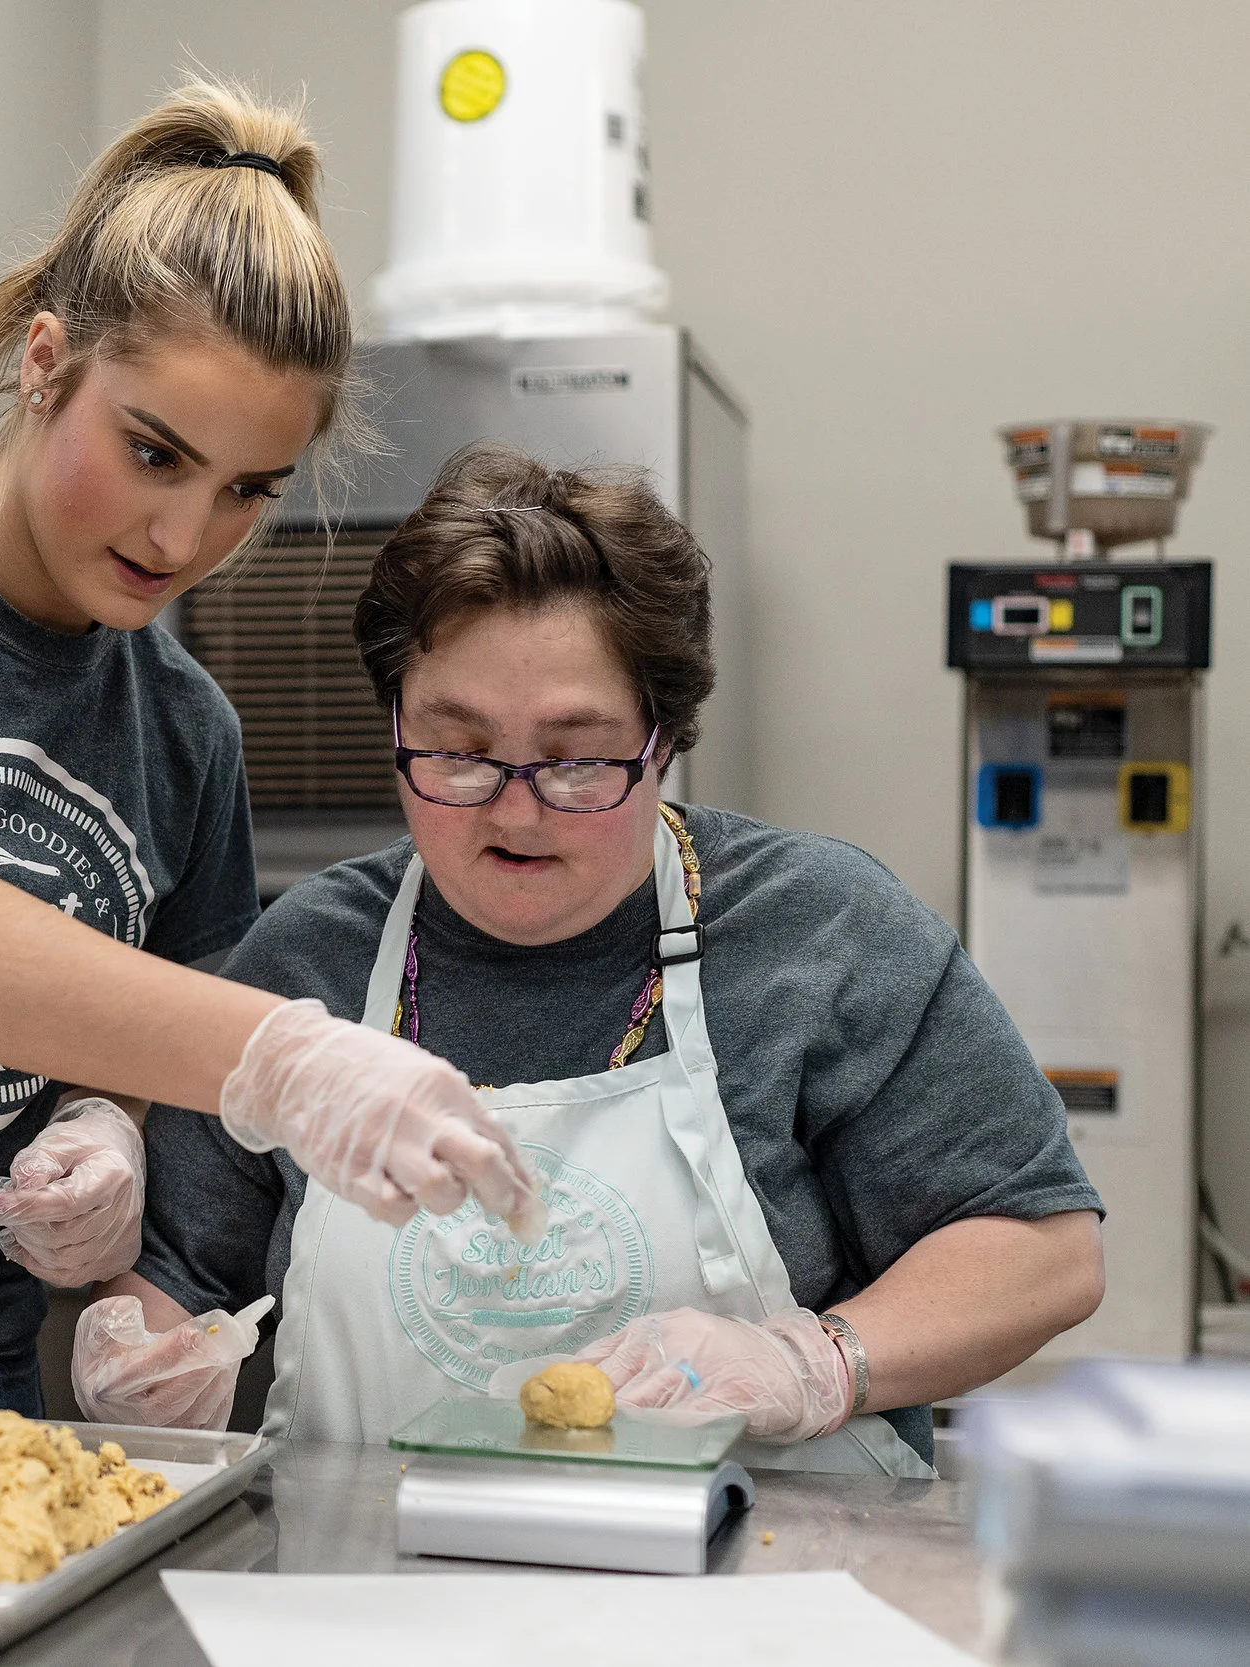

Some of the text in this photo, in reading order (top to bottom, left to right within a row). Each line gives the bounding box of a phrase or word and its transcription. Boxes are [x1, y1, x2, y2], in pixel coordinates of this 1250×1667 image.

[94, 897, 110, 918] &
[461, 1224, 568, 1266] Sweet
[434, 1257, 610, 1307] Jordan's
[449, 1323, 481, 1352] ICE
